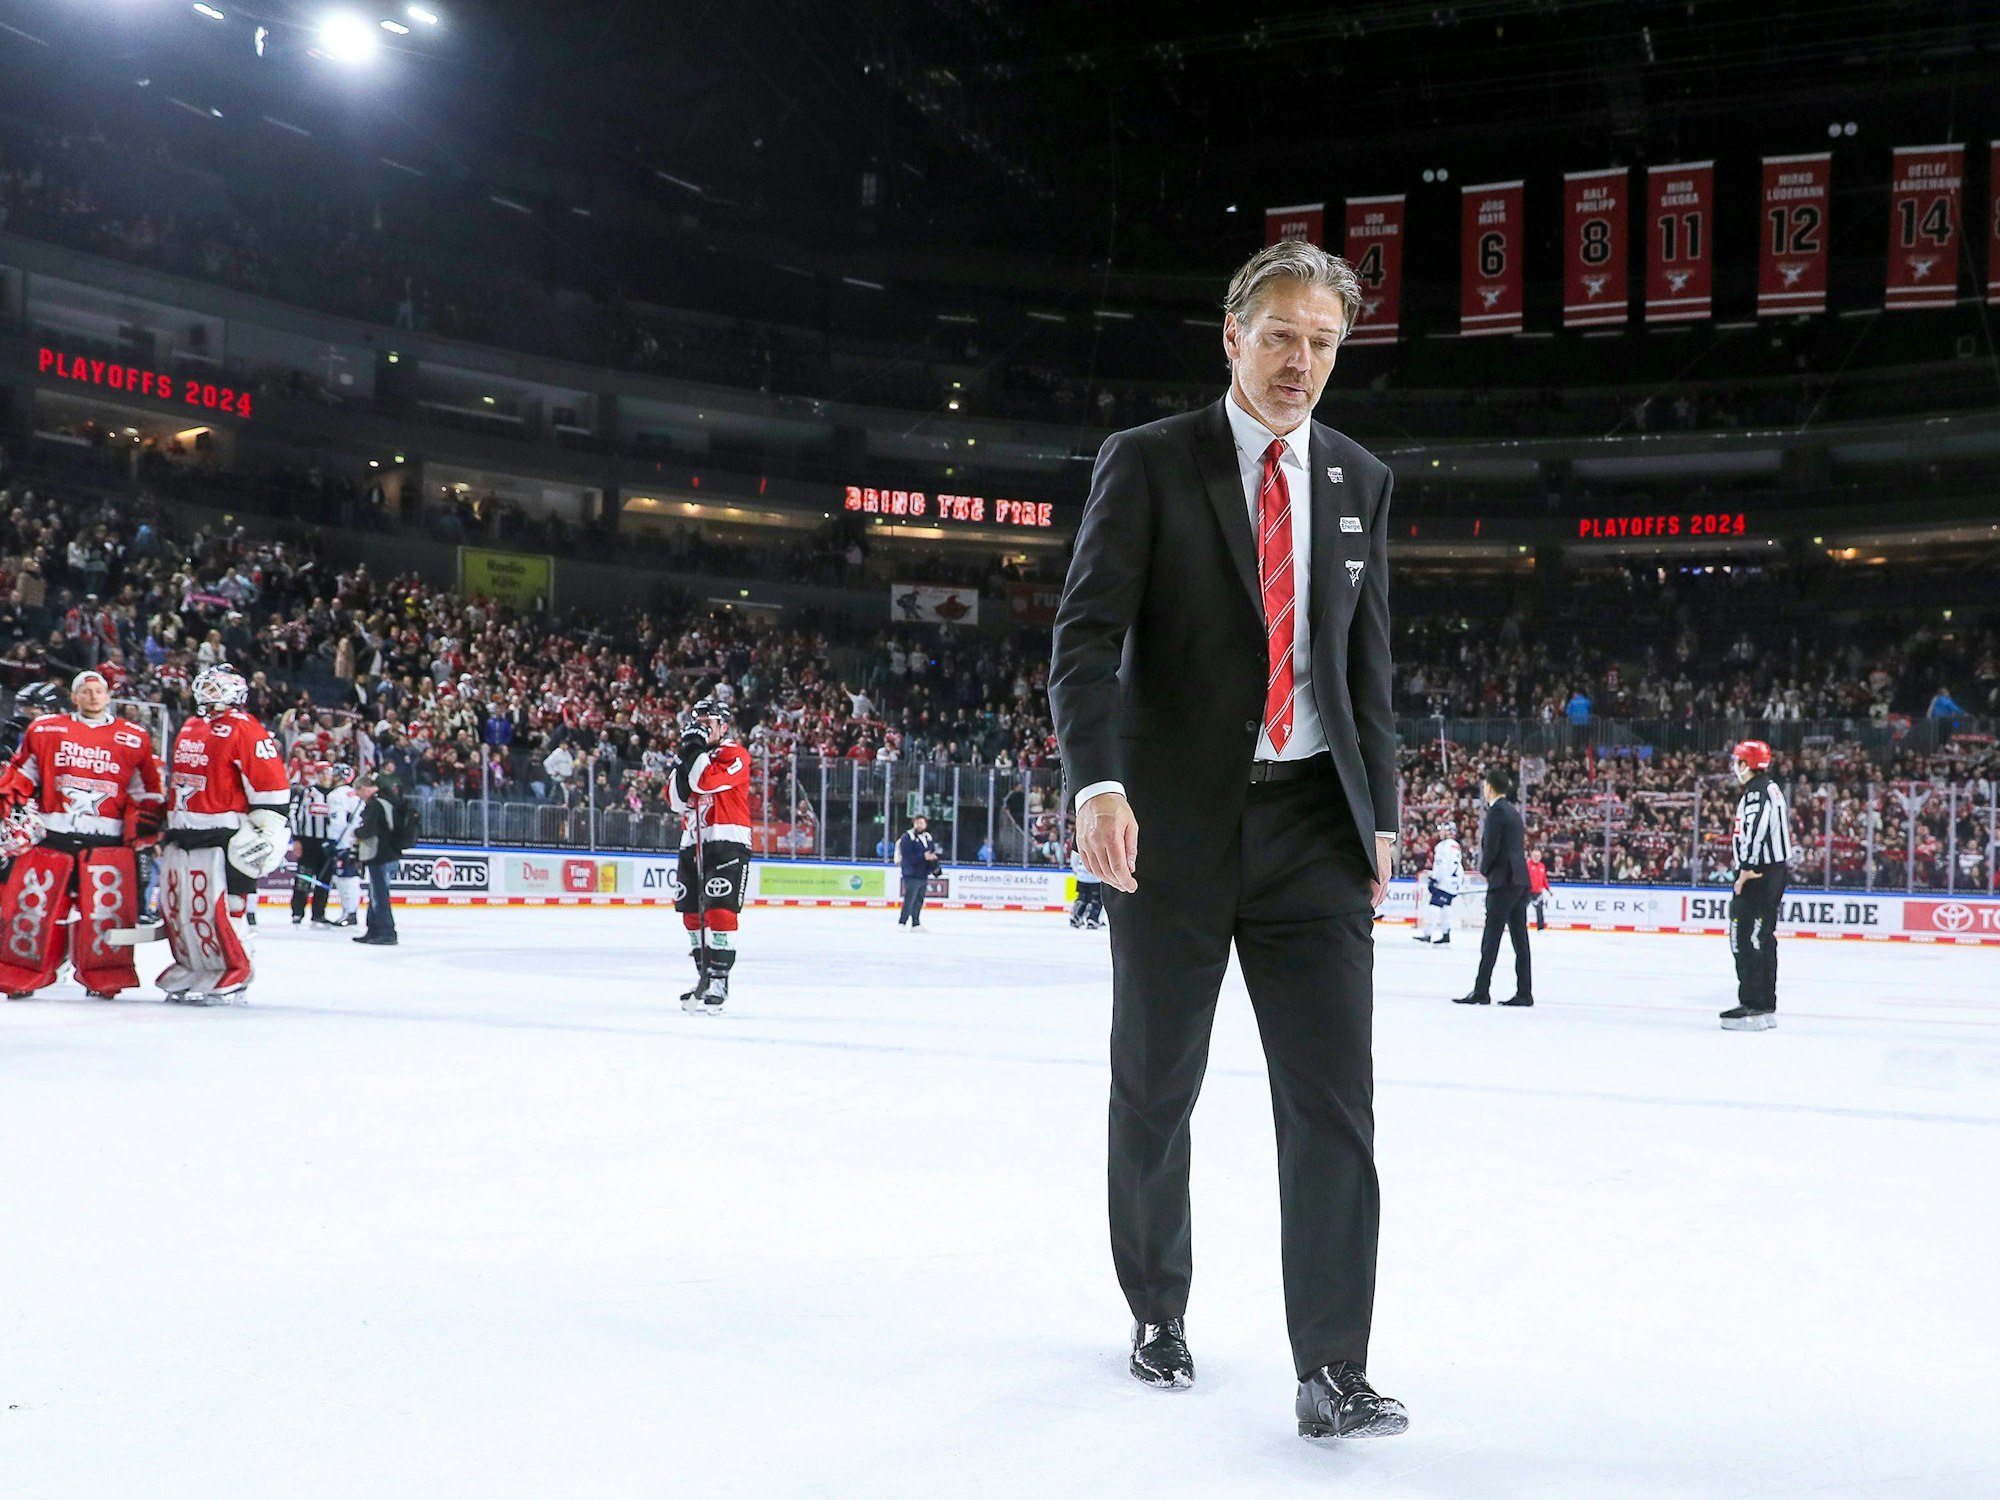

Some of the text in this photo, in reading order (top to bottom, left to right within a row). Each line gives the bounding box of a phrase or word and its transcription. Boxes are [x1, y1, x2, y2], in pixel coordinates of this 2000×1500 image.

[1583, 187, 1608, 200] RALF
[1579, 218, 1611, 265] 8
[1658, 211, 1701, 262] 11
[1768, 205, 1822, 255] 12
[1897, 196, 1953, 248] 14
[1356, 243, 1386, 289] 4
[1479, 231, 1506, 278] 6
[38, 348, 252, 418] PLAYOFFS 2024
[845, 486, 1053, 527] BRING THE FIRE
[1579, 513, 1747, 538] PLAYOFFS 2024
[54, 752, 120, 774] Energie
[60, 741, 111, 761] Rhein
[179, 738, 205, 754] Rhein
[255, 738, 278, 760] 45
